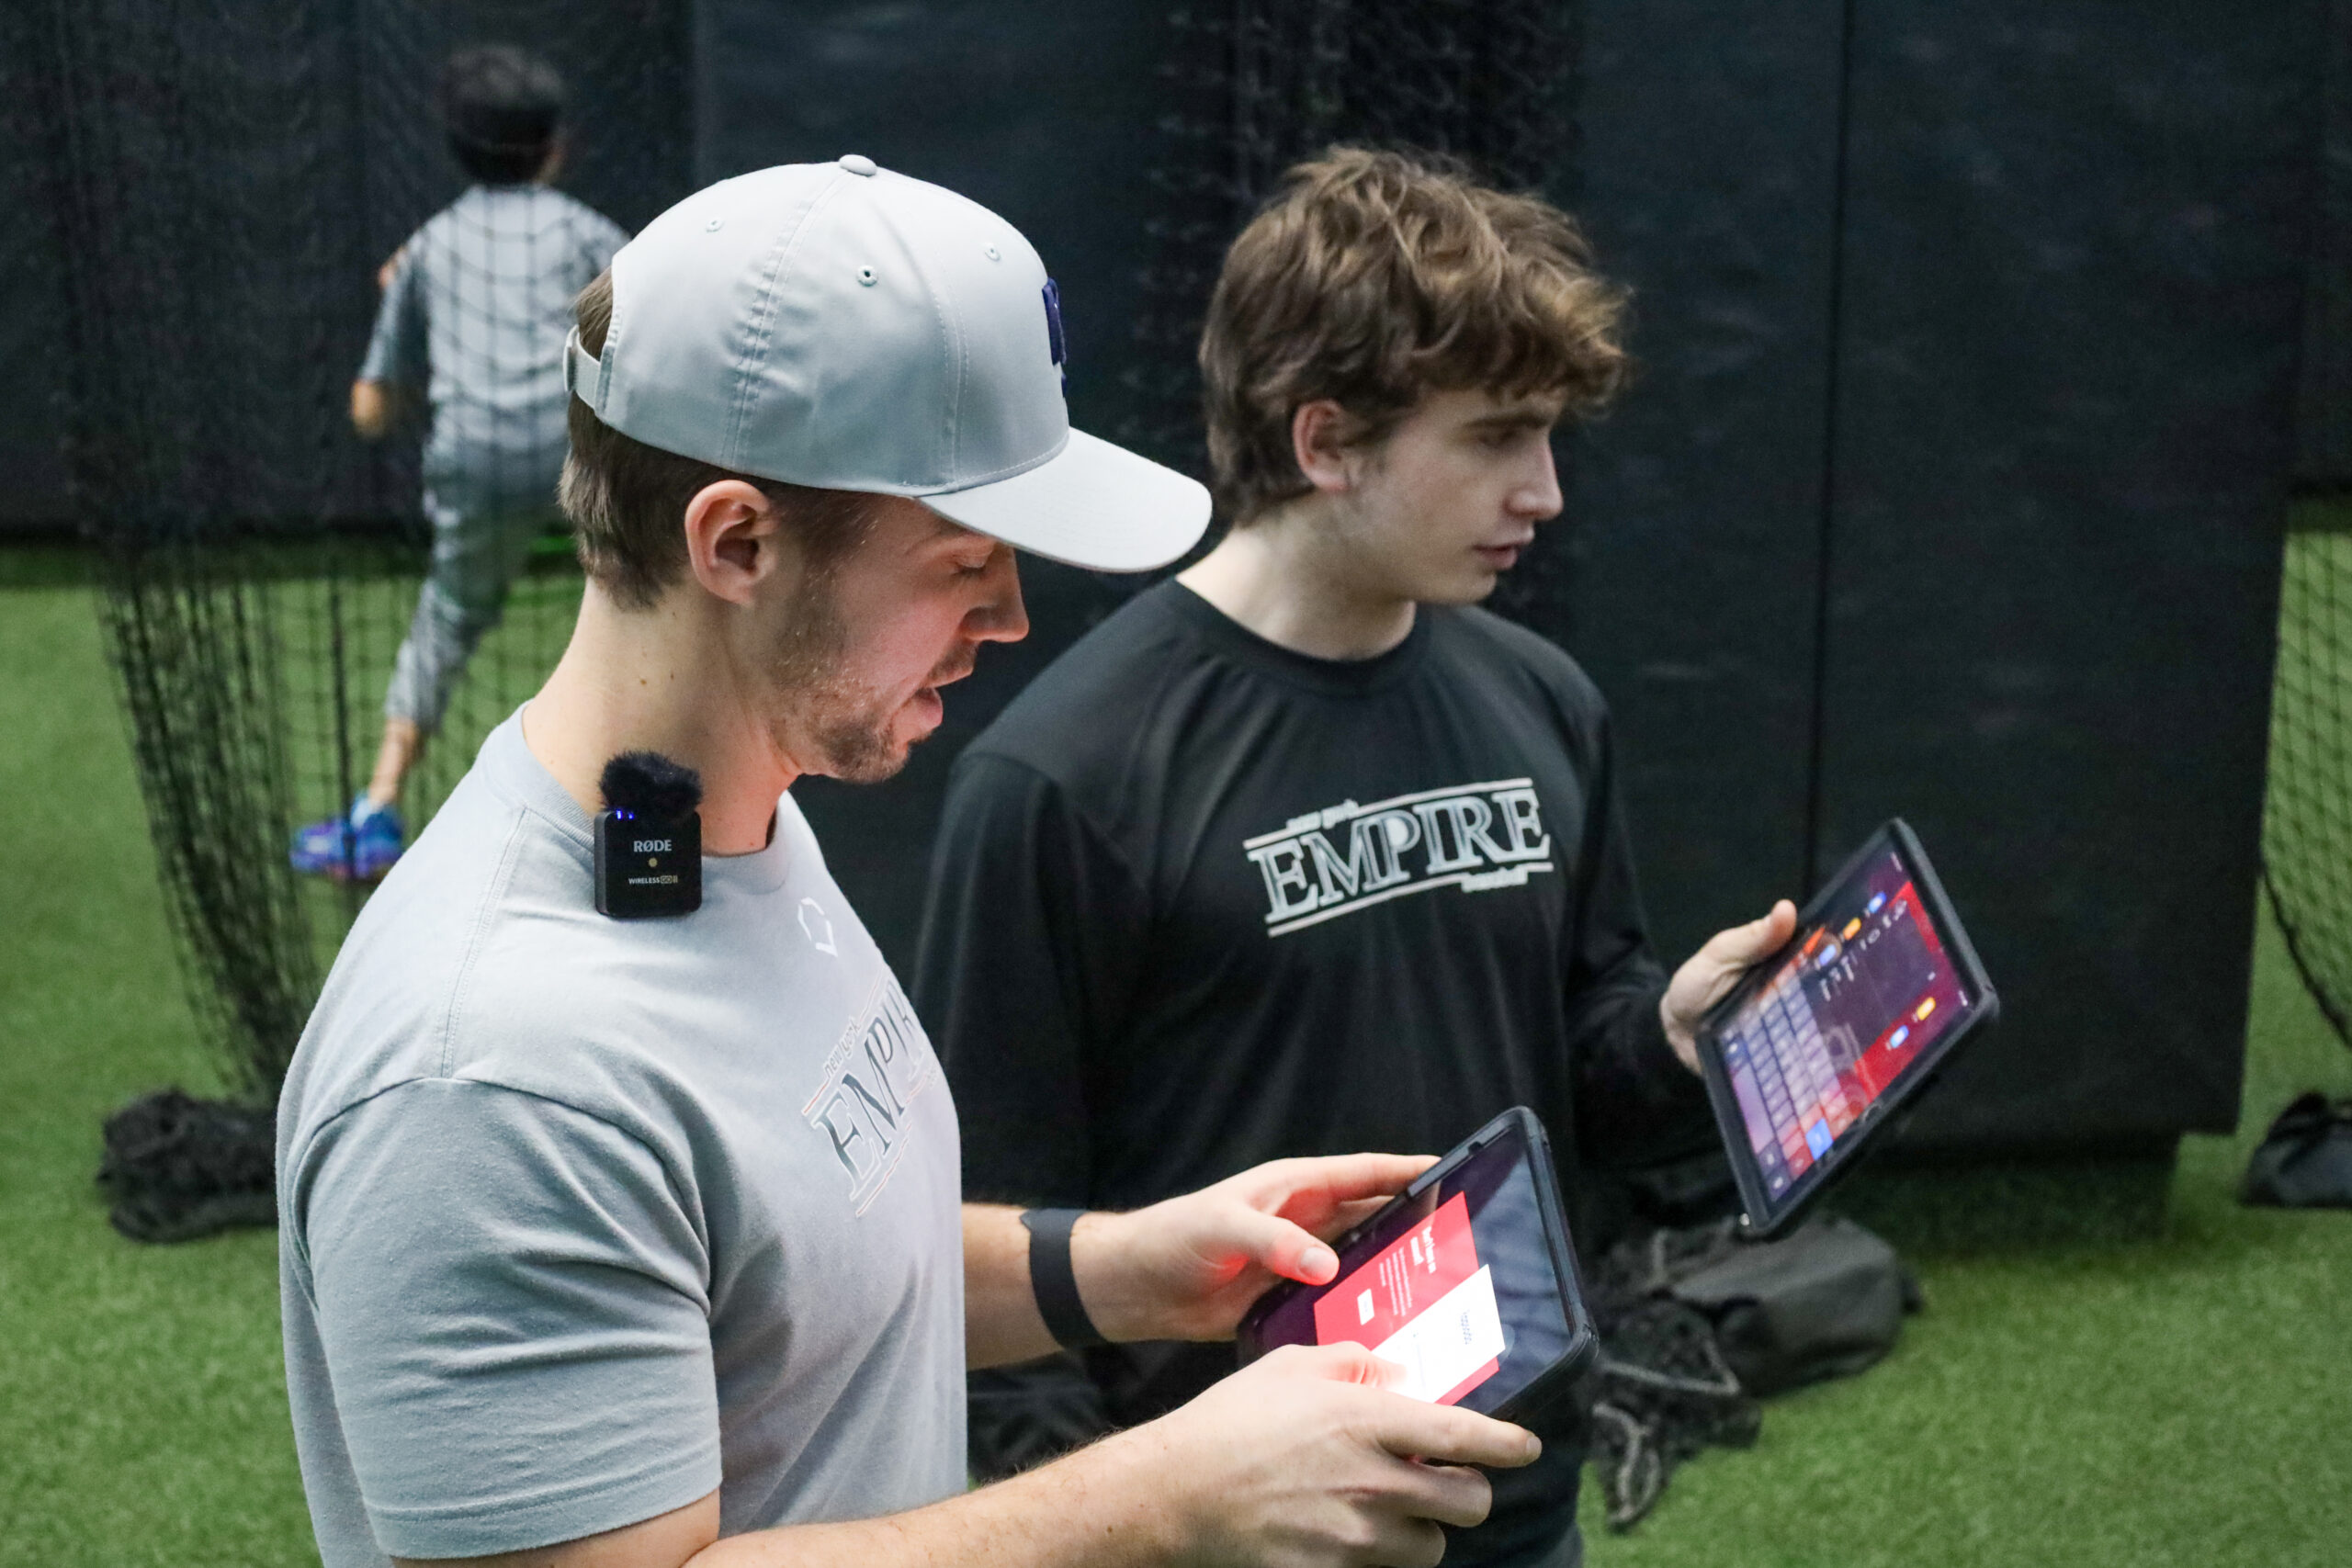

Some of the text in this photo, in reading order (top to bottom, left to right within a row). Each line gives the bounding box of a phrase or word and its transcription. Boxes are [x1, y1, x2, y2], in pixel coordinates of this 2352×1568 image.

[633, 840, 672, 852] RØDE
[1247, 787, 1551, 924] EMPIRE
[810, 978, 922, 1201] EMPIR
